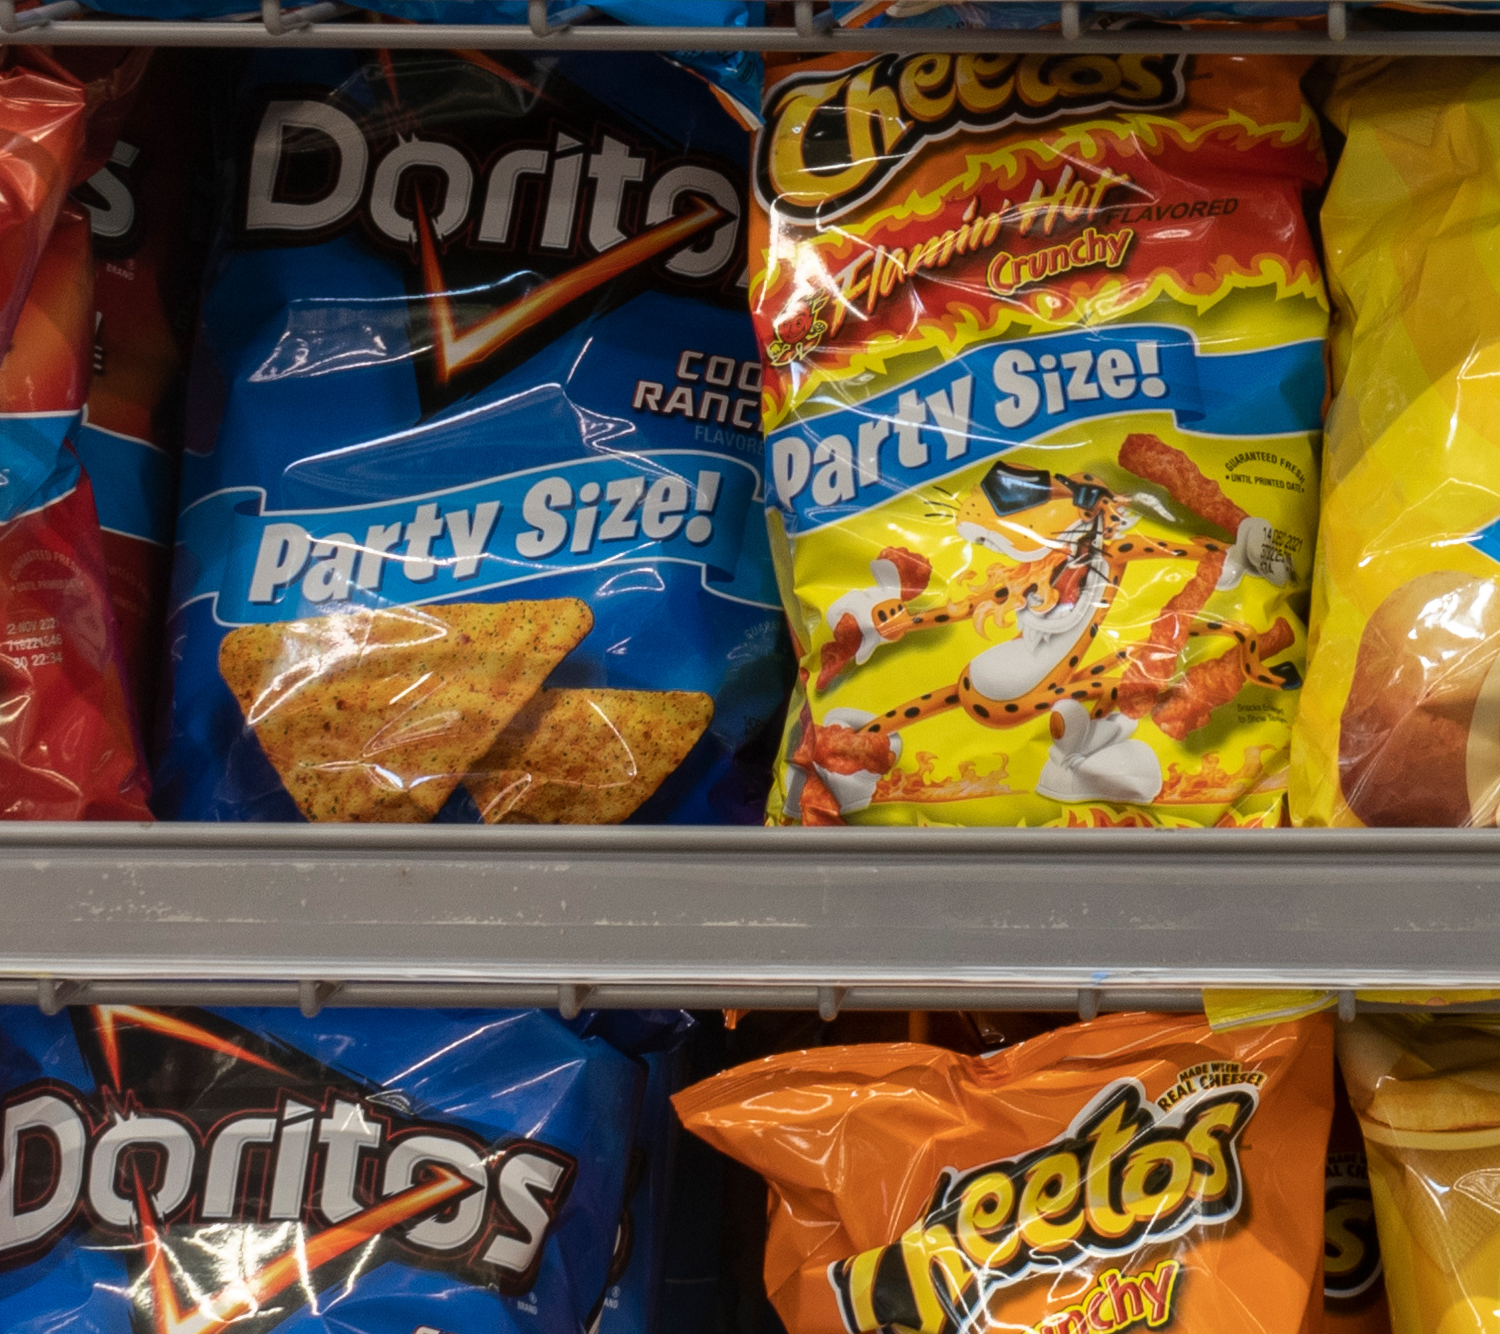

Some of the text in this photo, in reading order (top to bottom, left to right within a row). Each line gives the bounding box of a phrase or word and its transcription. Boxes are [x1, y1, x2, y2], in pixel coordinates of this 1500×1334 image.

[247, 97, 744, 279] Dorito
[987, 227, 1136, 297] Crunchy
[770, 342, 1168, 510] Party Size!
[1225, 451, 1306, 483] GUARANTEED FRESH
[1231, 474, 1285, 488] UNTIL PRINTED
[247, 470, 721, 604] Party Size!
[1156, 1072, 1265, 1111] REAL CHEESE!
[1179, 1064, 1209, 1082] MADE
